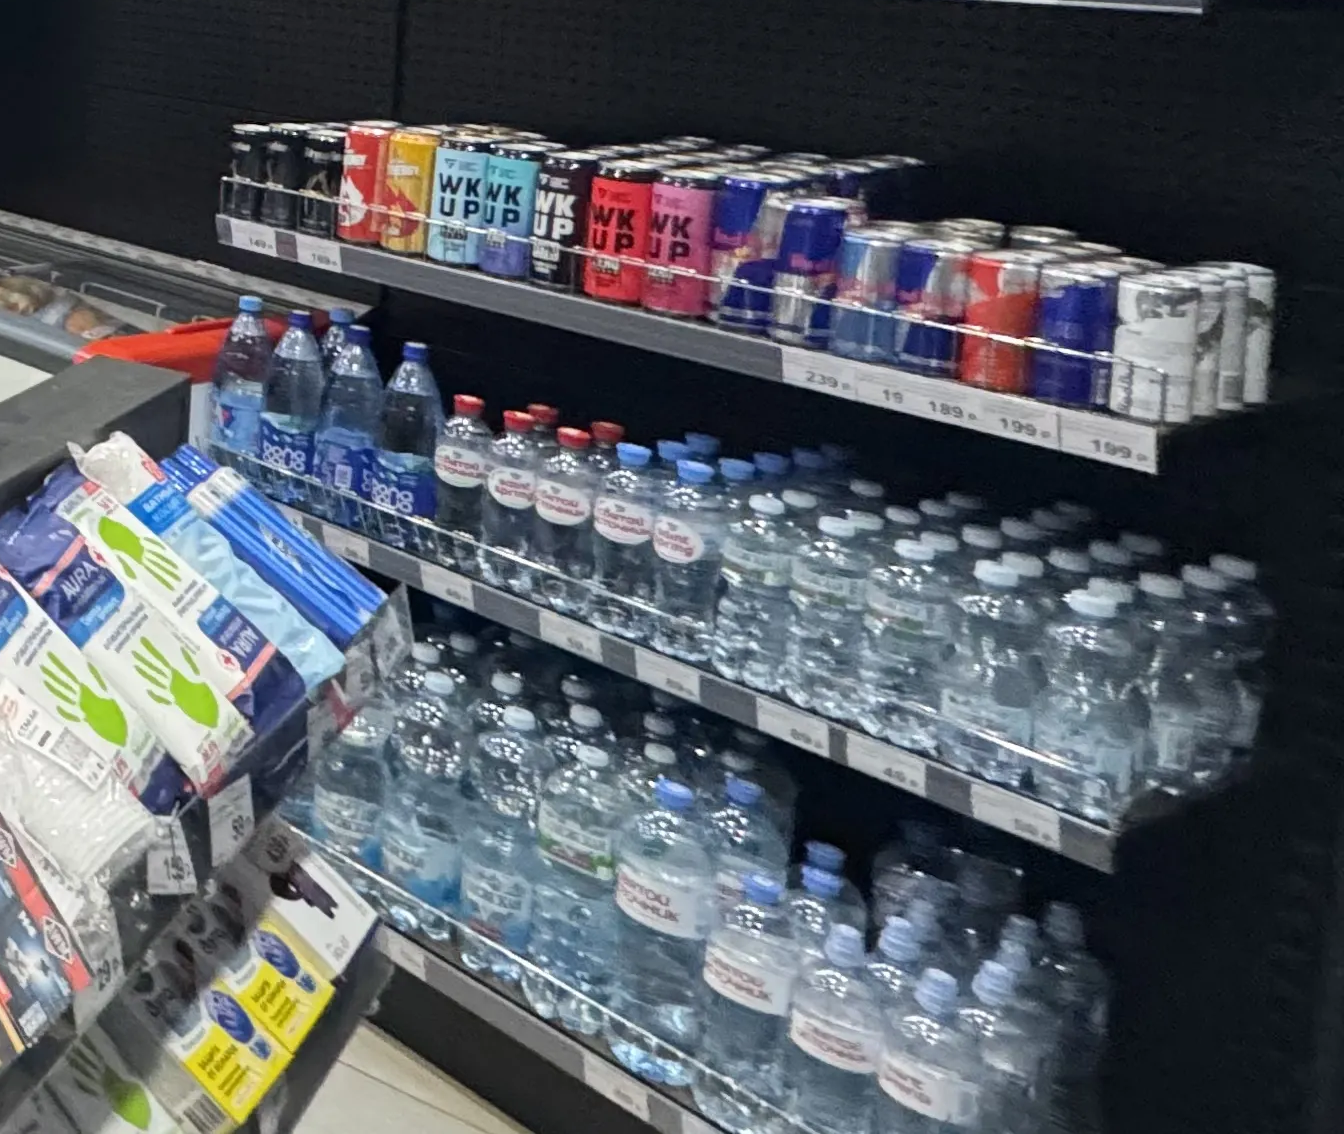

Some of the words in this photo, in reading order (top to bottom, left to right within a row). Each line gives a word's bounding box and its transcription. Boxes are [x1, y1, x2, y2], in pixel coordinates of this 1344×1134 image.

[439, 172, 482, 198] WK
[440, 197, 480, 218] UP
[535, 190, 579, 218] WK
[533, 213, 575, 241] UP
[592, 205, 637, 232] WK
[592, 228, 636, 254] UP
[60, 560, 101, 603] AURA
[233, 626, 260, 659] AURA
